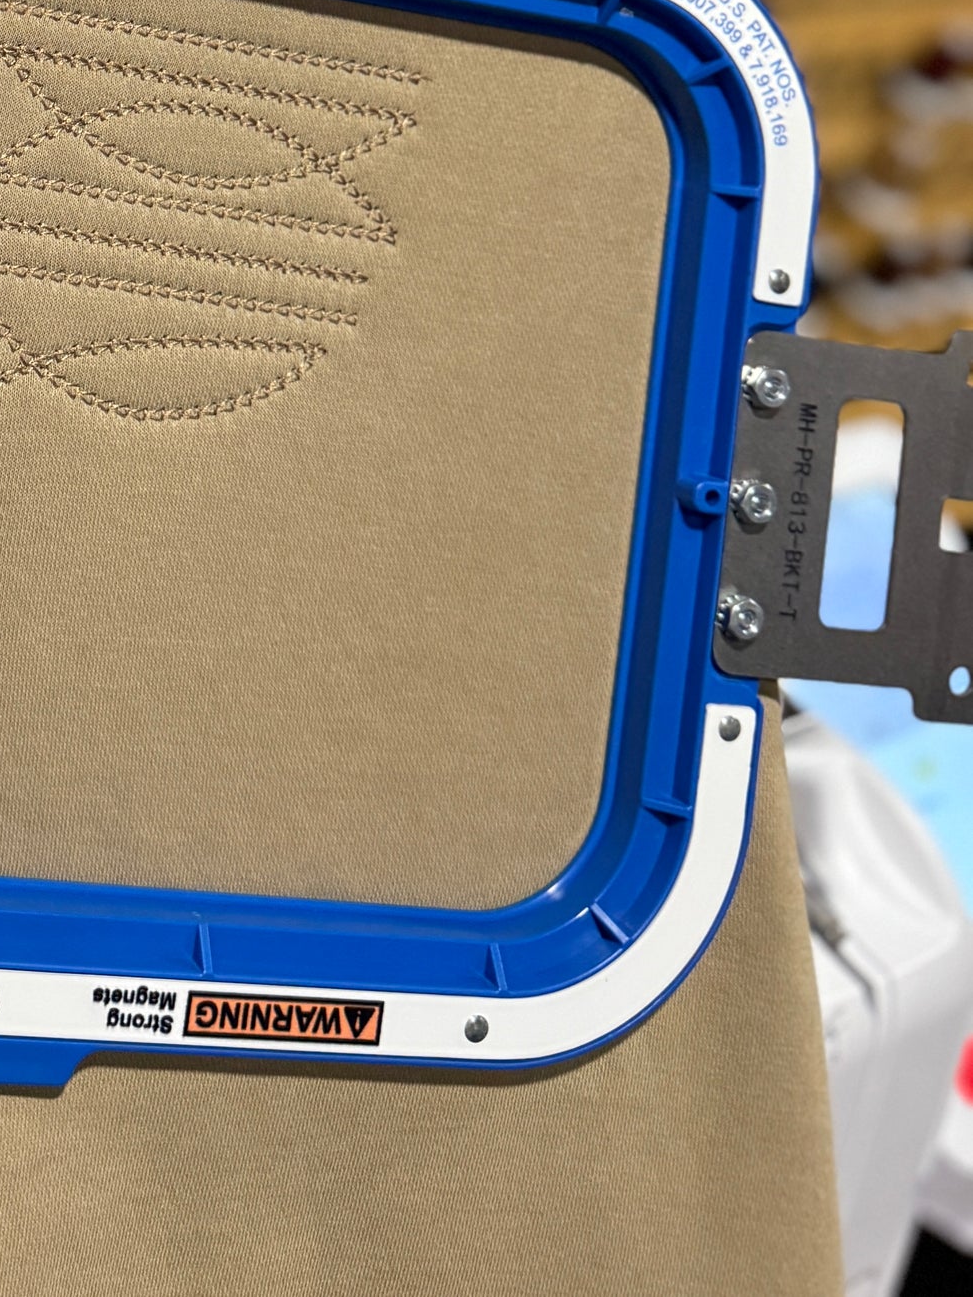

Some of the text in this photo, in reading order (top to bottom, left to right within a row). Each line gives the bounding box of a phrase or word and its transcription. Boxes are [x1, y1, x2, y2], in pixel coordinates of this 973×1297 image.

[738, 43, 753, 60] &
[748, 58, 788, 147] 7,918,169
[746, 19, 777, 58] PAT.
[769, 58, 797, 108] NOS.
[777, 402, 820, 622] MH-PR-813-BKT-T
[91, 985, 177, 1012] Magnets
[105, 1006, 175, 1036] Strong
[194, 999, 342, 1036] WARNING
